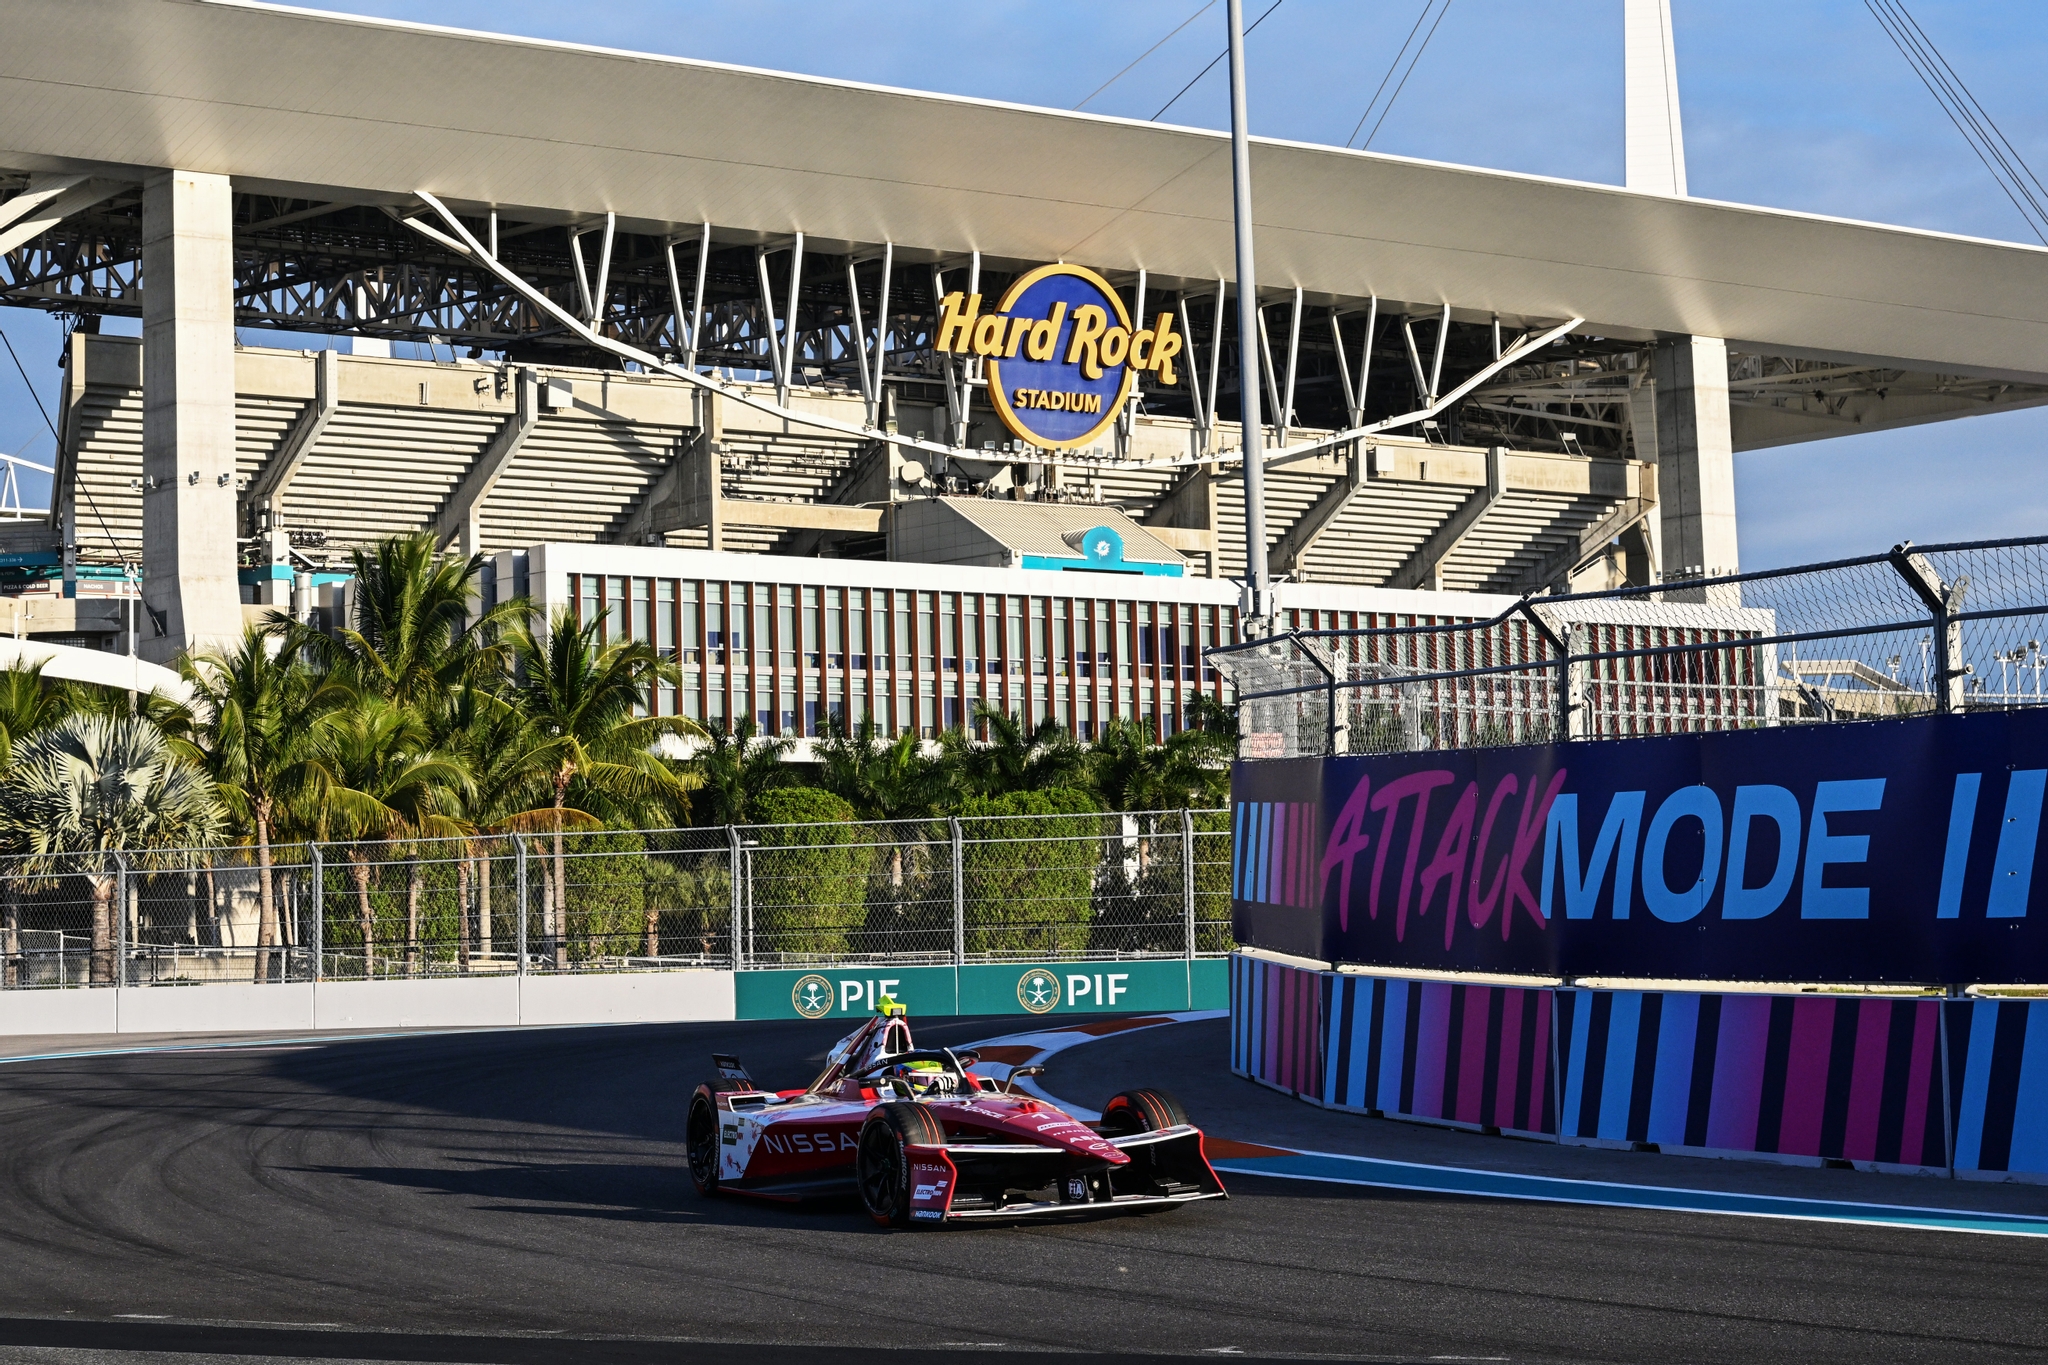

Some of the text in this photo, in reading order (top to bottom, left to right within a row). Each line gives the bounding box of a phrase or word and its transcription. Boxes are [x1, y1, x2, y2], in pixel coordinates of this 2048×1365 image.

[933, 291, 1183, 386] Hard Rock
[1013, 388, 1102, 414] STADIUM
[1319, 768, 1887, 951] ATTACK MODE
[1066, 973, 1129, 1006] PIF
[763, 1131, 859, 1154] NISSA
[913, 1163, 946, 1172] NISSAN
